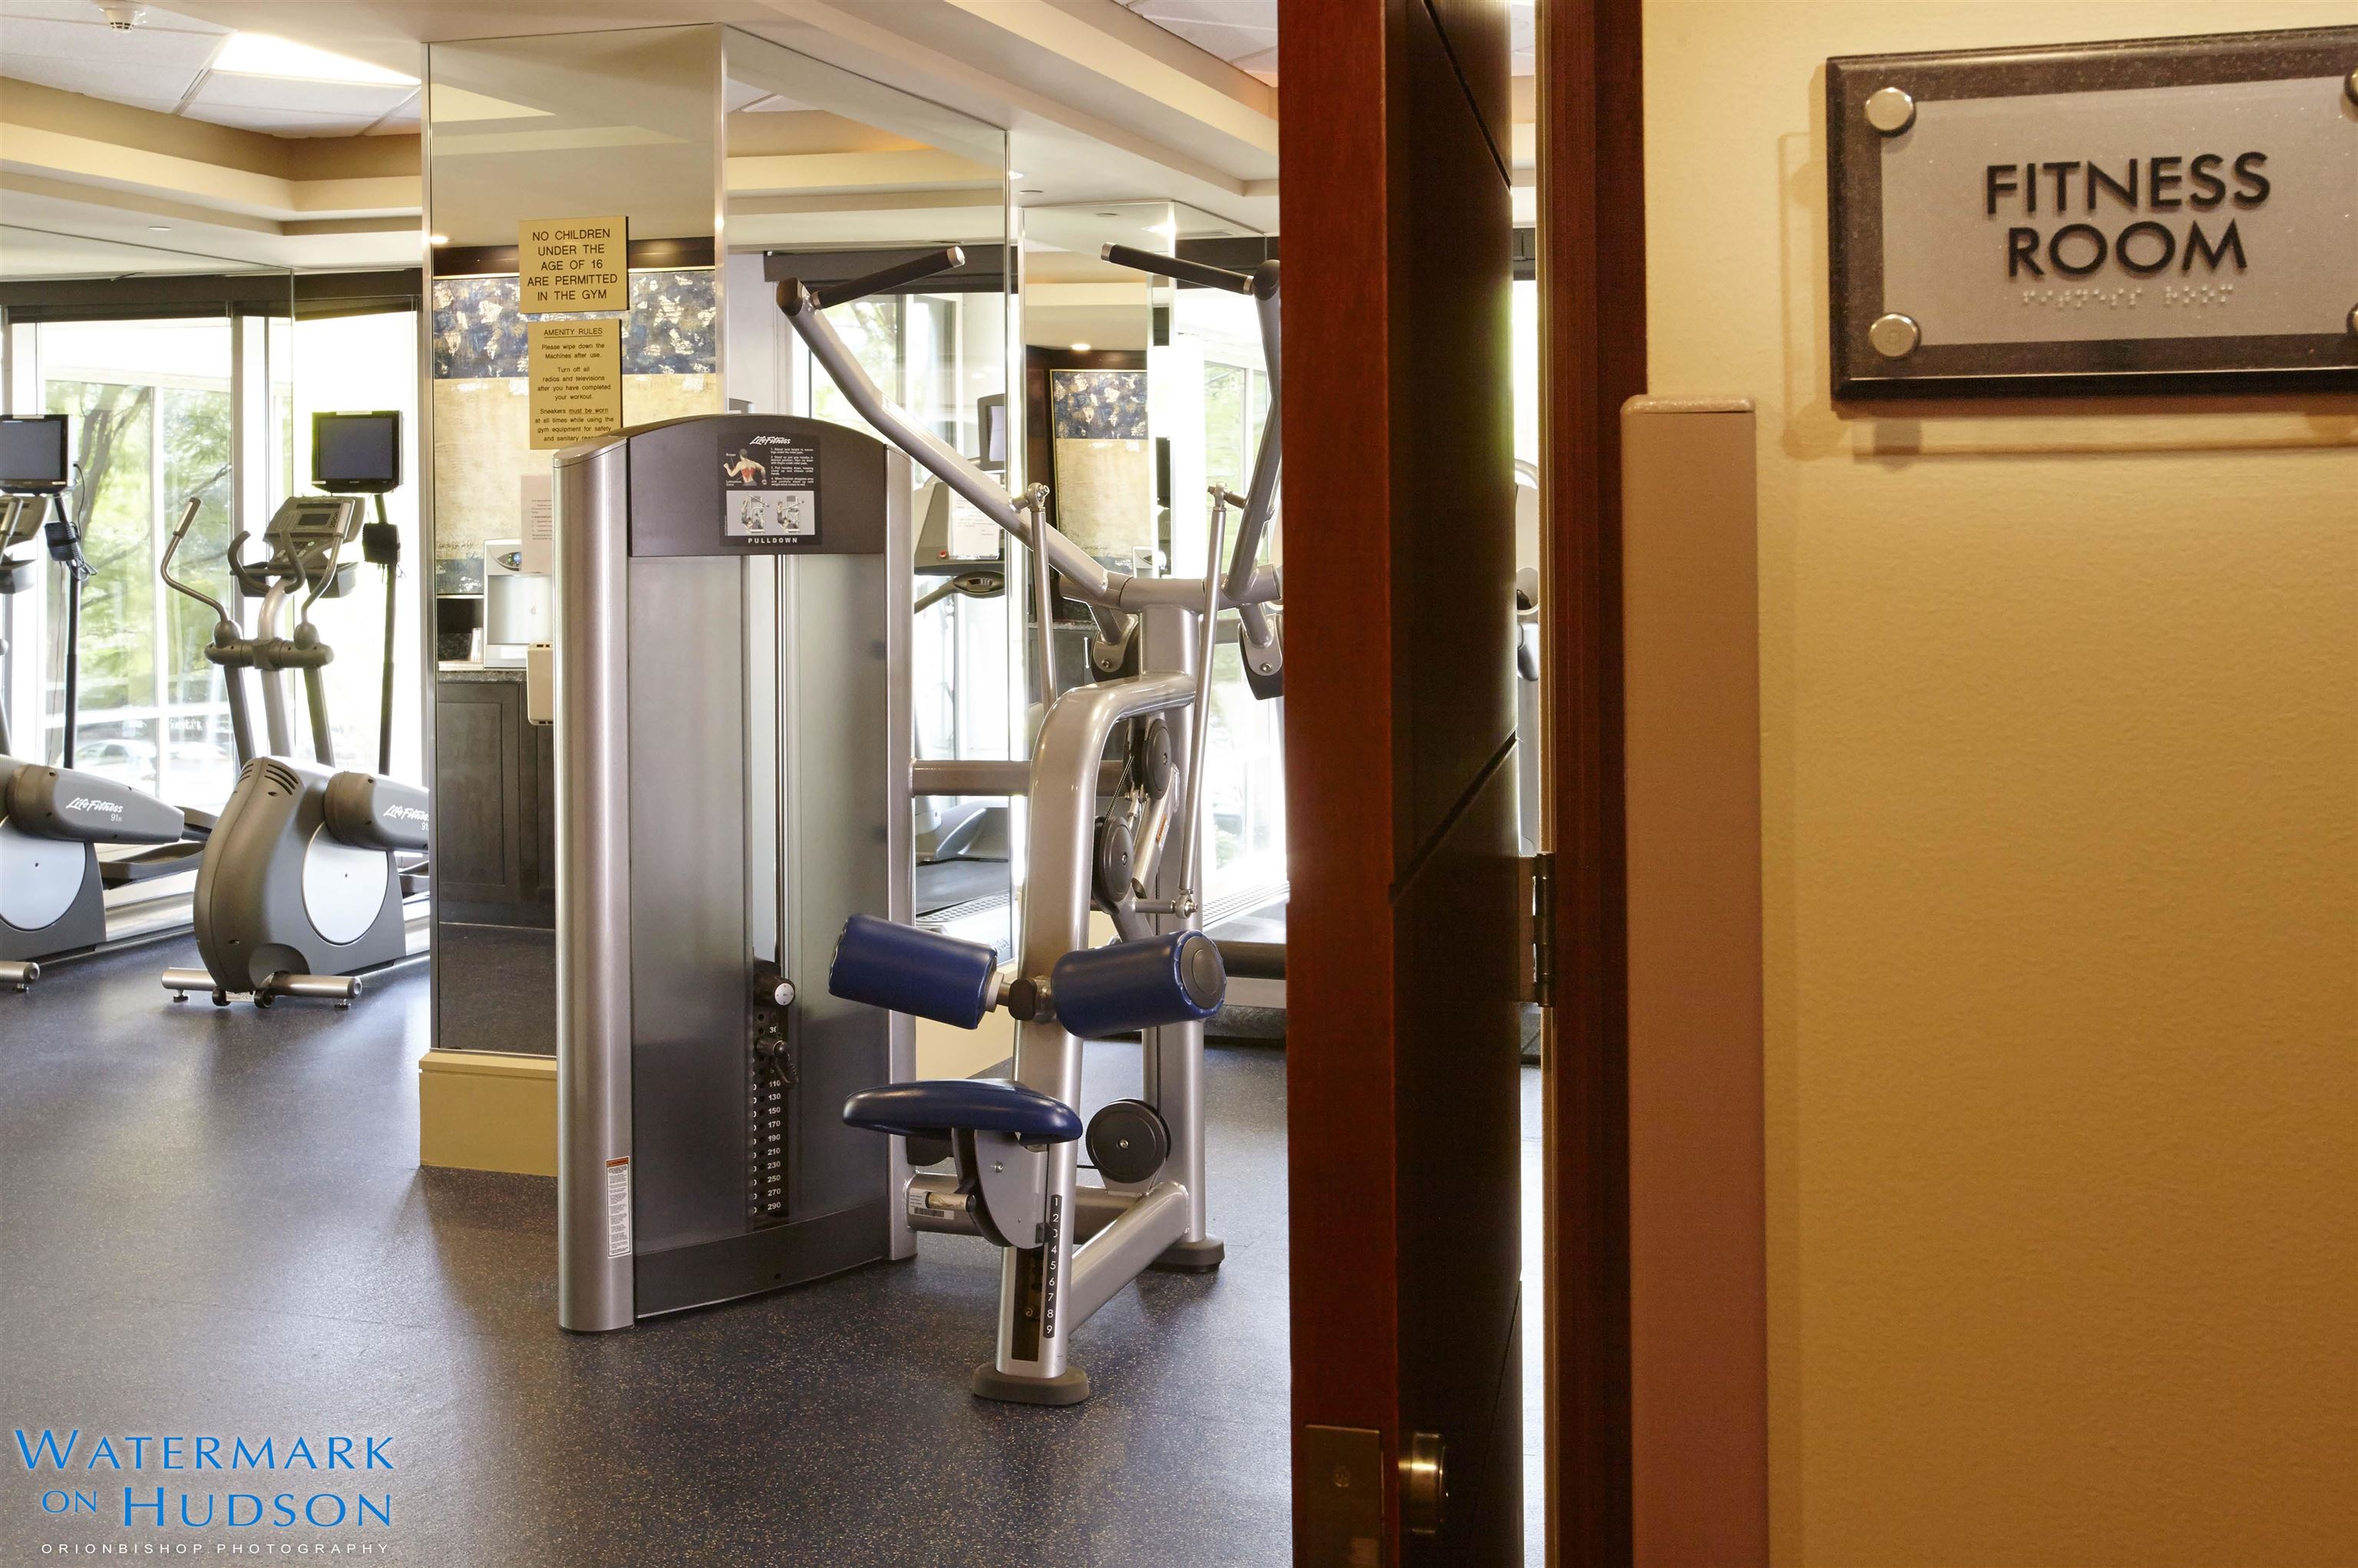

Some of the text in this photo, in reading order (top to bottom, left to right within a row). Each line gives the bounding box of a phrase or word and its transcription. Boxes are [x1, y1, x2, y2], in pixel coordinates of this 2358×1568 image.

[1986, 150, 2271, 216] FITNESS
[533, 229, 610, 241] NO CHILDREN
[538, 244, 605, 256] UNDER THE
[2006, 216, 2248, 278] ROOM
[541, 259, 603, 271] AGE OF 16
[527, 274, 618, 286] ARE PERMITTED
[537, 289, 606, 301] IN THE GYM
[768, 1120, 781, 1128] 170
[768, 1134, 781, 1142] 190
[768, 1147, 781, 1156] 210
[768, 1160, 781, 1170] 230
[768, 1174, 781, 1183] 250
[768, 1188, 781, 1197] 270
[768, 1201, 781, 1210] 290
[1055, 1197, 1058, 1207] 1
[1052, 1213, 1059, 1222] 2
[1051, 1245, 1057, 1254] 4
[1050, 1261, 1056, 1269] 5
[1049, 1277, 1055, 1286] 6
[1048, 1293, 1054, 1302] 7
[1046, 1309, 1053, 1319] 8
[1046, 1325, 1052, 1334] 9
